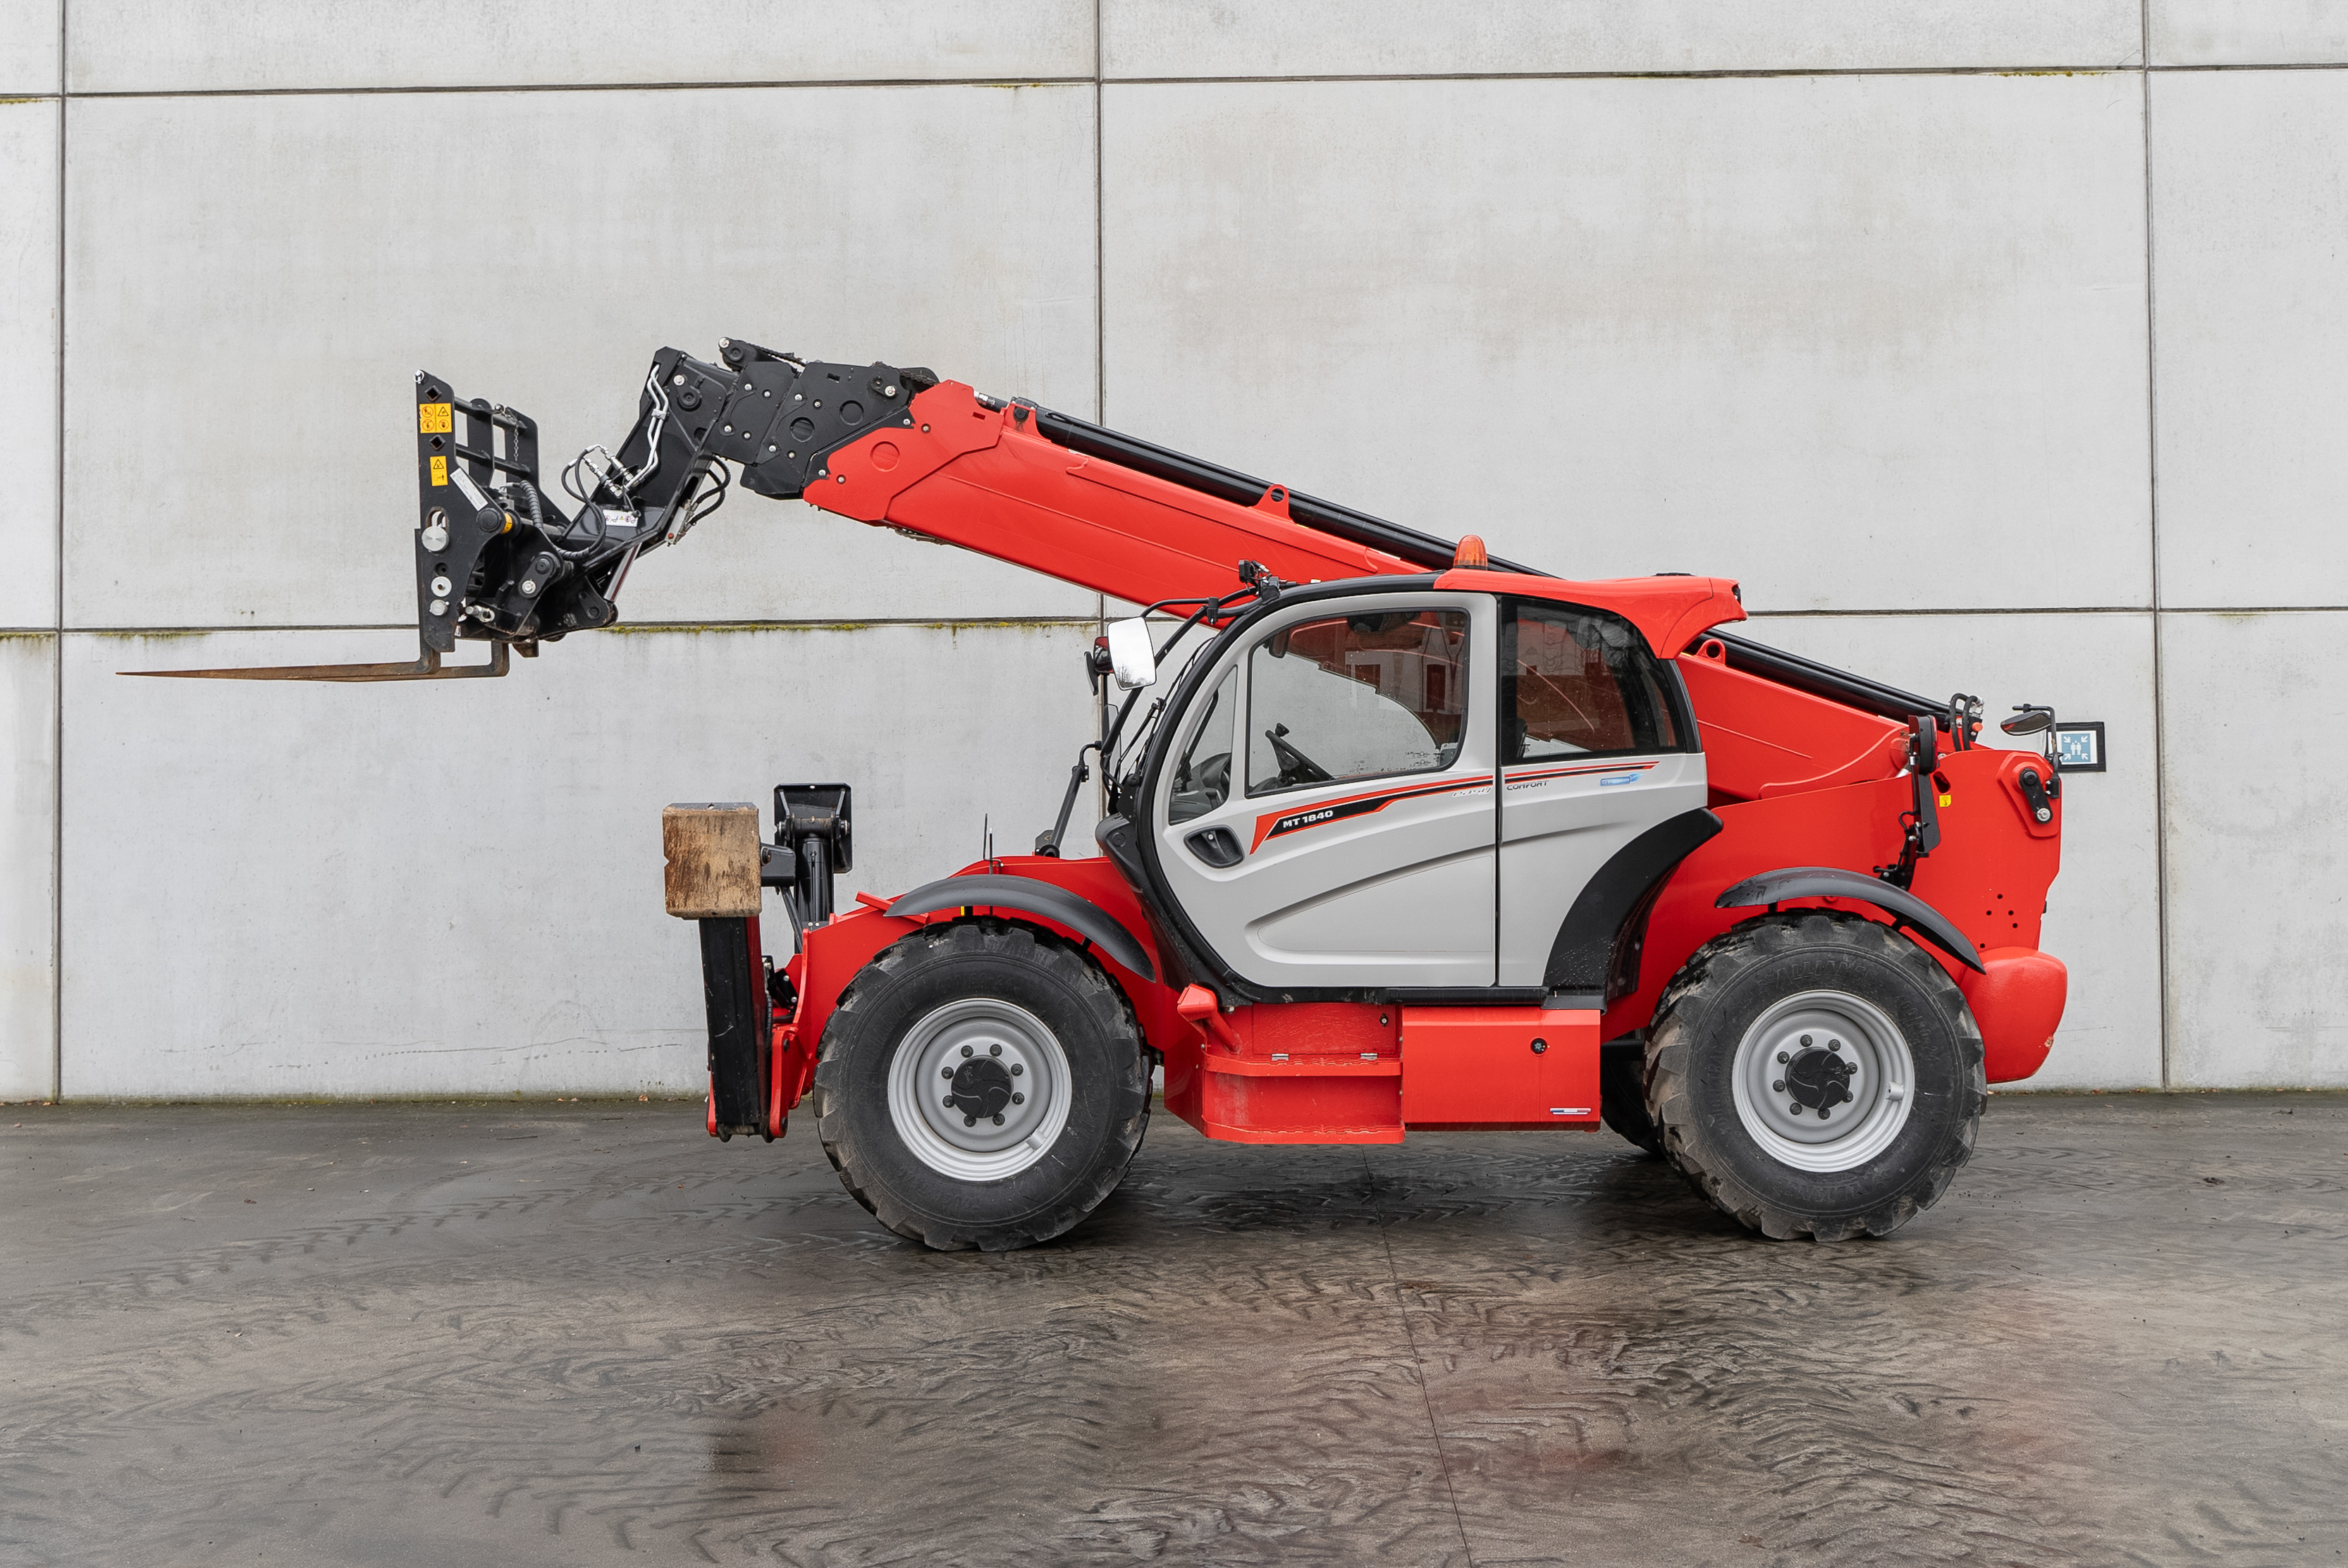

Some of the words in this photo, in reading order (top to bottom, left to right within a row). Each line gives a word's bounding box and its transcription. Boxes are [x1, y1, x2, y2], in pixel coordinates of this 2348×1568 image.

[1506, 779, 1549, 791] COMFORT
[1283, 818, 1300, 828] MT
[1302, 810, 1334, 823] 1840
[1776, 961, 1878, 989] ALLIANCE
